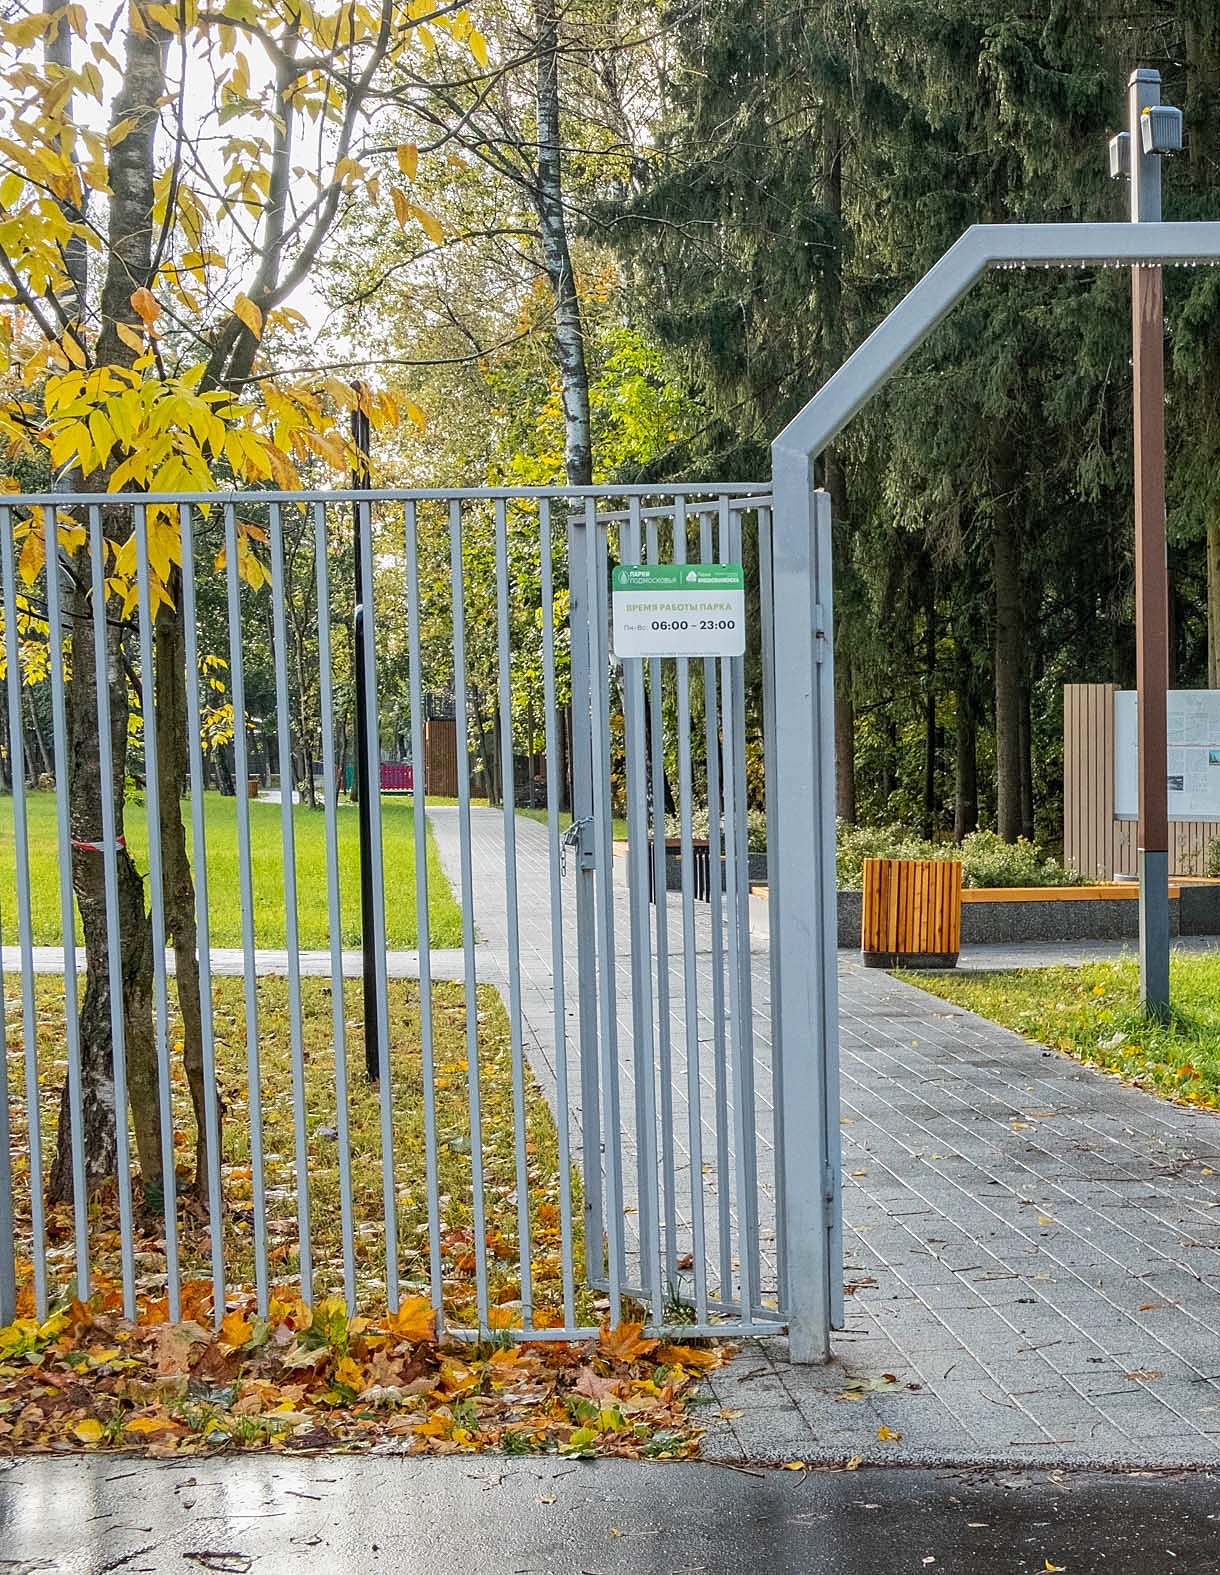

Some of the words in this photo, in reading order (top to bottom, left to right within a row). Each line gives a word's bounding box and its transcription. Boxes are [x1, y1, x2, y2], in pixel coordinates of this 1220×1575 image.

[626, 603, 658, 612] ВРЕМЯ
[660, 603, 698, 612] РАБОТЫ
[700, 602, 733, 611] ПАРКА
[651, 620, 688, 631] 06:00
[700, 620, 735, 630] 23:00
